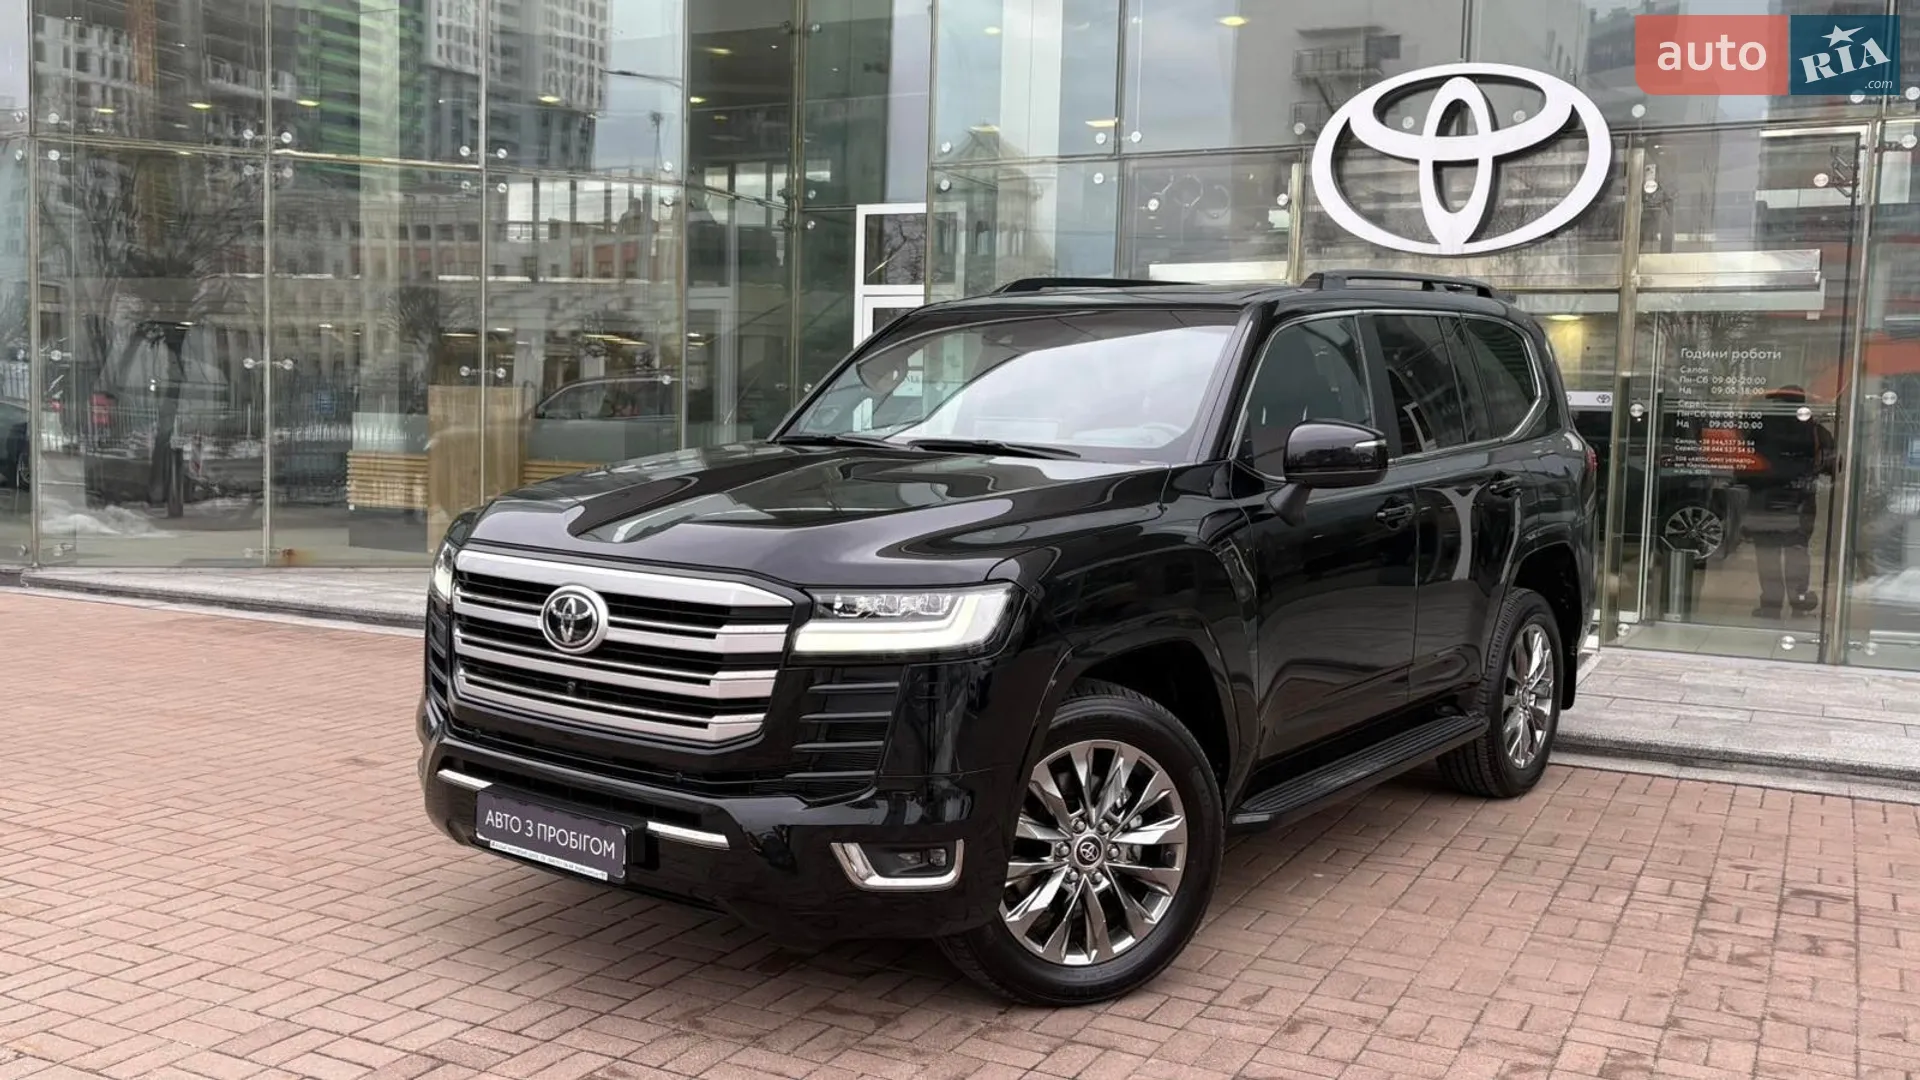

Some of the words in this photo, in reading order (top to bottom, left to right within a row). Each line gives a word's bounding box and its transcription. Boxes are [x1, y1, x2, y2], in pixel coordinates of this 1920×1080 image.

[1681, 348, 1728, 360] Години
[1731, 347, 1782, 362] роботи
[1676, 420, 1690, 428] Нд
[485, 809, 522, 834] АВТО
[537, 823, 616, 860] ПРОБІГОМ
